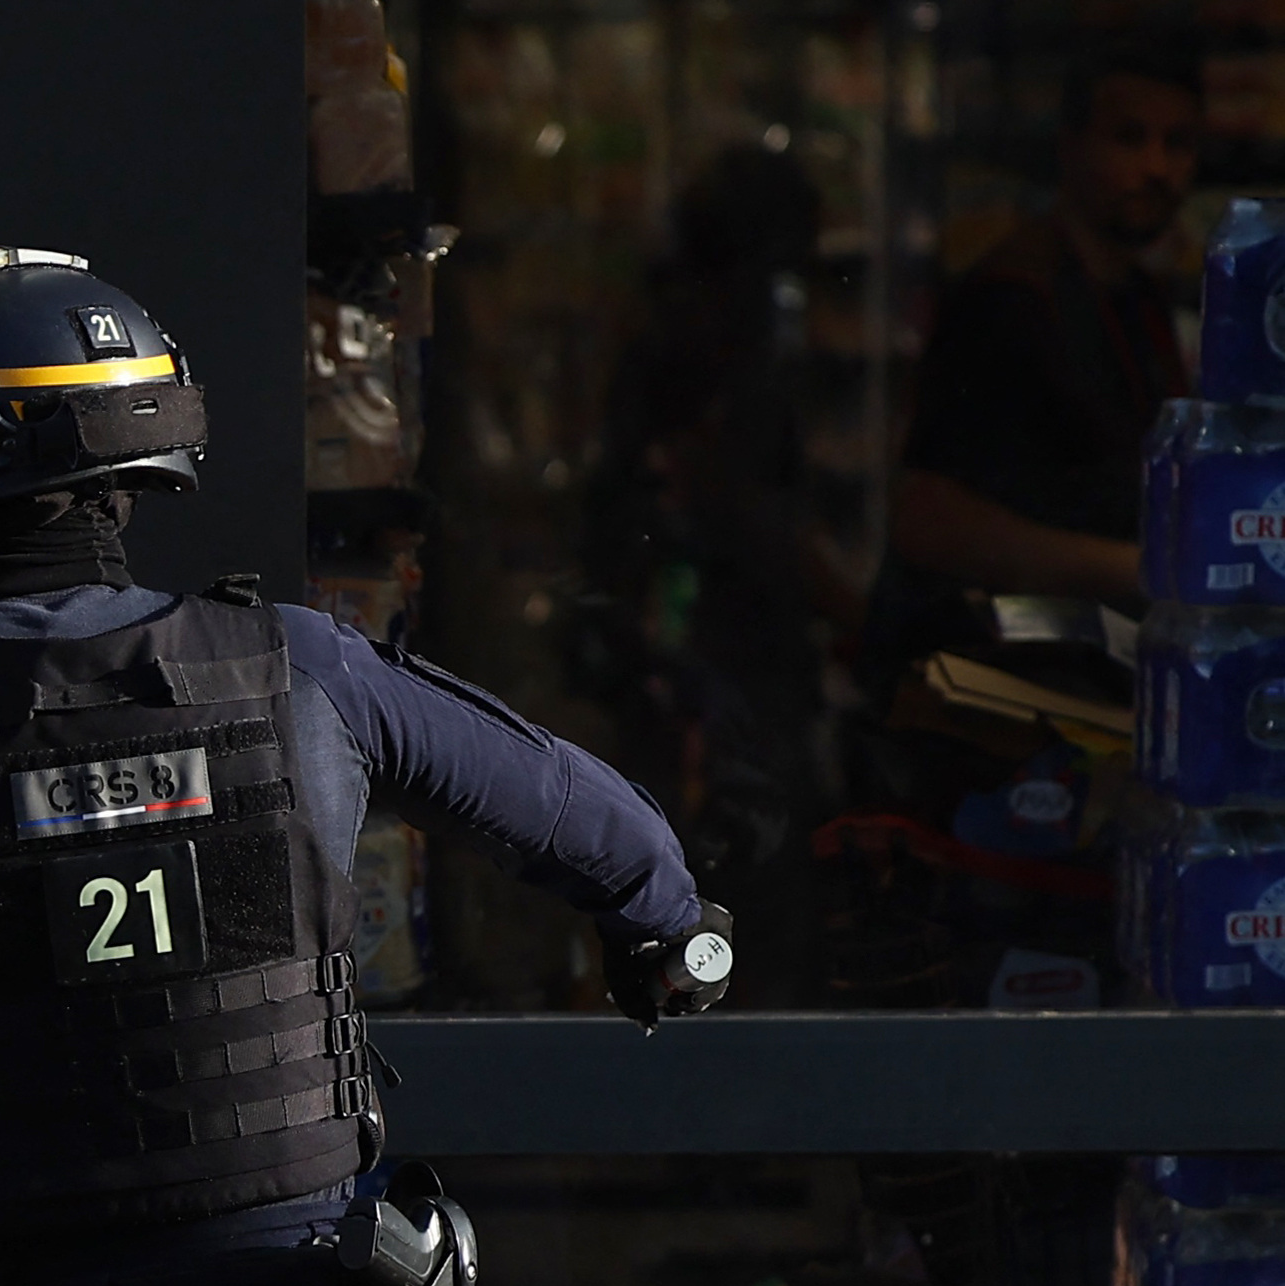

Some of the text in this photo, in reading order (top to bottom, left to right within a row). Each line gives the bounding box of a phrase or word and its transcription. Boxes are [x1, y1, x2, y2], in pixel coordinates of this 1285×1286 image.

[90, 314, 121, 342] 21
[47, 764, 175, 813] CRS 8
[79, 867, 174, 963] 21
